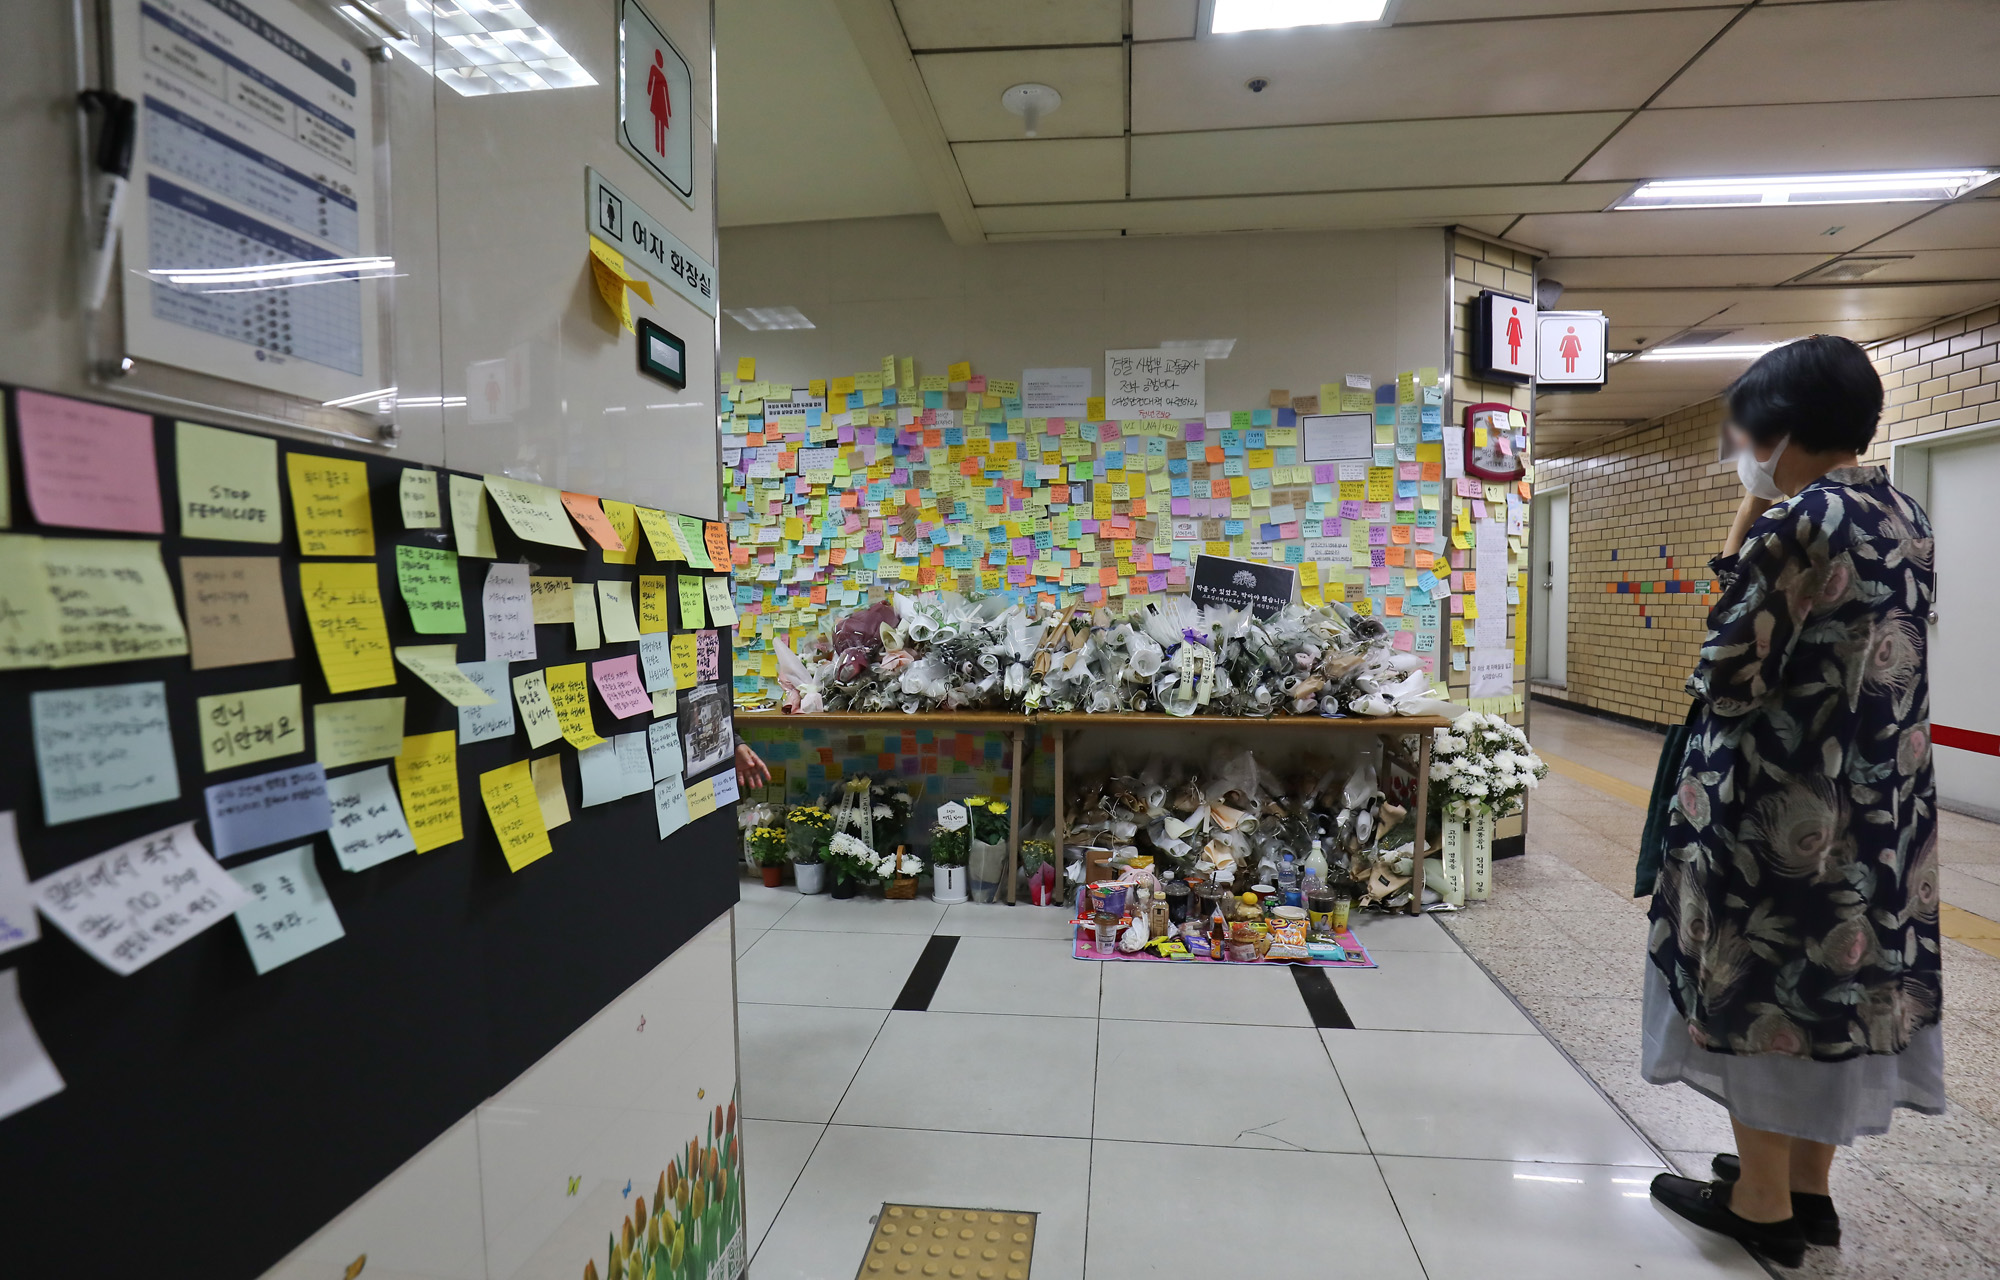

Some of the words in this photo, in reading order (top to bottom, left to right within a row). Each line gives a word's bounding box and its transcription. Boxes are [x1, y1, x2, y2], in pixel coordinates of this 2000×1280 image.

[633, 220, 664, 264] 여자
[670, 249, 711, 299] 화장실
[1110, 356, 1134, 376] 경찰
[1136, 356, 1163, 375] 사법부
[1163, 358, 1200, 375] 교통공사
[1143, 379, 1180, 392] 공범이다
[210, 485, 251, 500] STOP
[189, 502, 267, 522] FEMICIDE
[1196, 584, 1209, 593] 막을
[1218, 588, 1239, 598] 있었고,
[1241, 592, 1260, 601] 막아야
[1261, 595, 1287, 605] 했습니다
[210, 700, 245, 726] 언니
[211, 717, 295, 757] 미안해요
[1448, 830, 1457, 847] 고인의
[1448, 853, 1457, 870] 명복을
